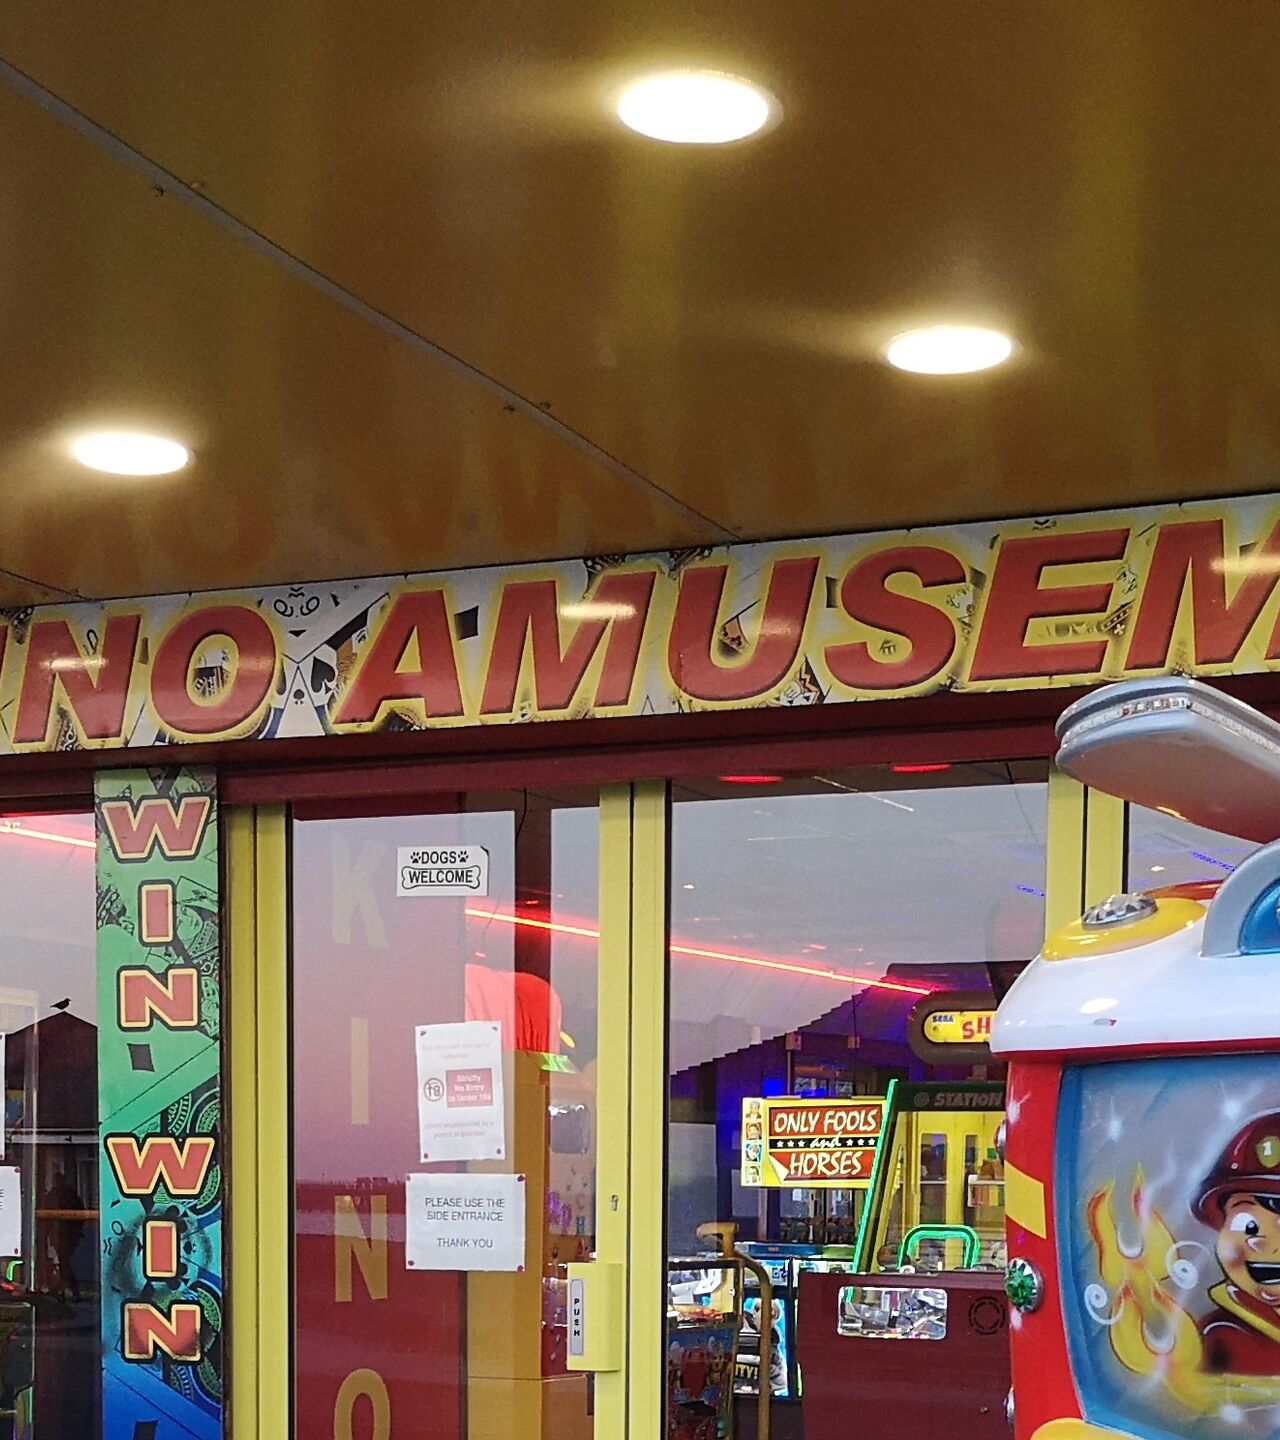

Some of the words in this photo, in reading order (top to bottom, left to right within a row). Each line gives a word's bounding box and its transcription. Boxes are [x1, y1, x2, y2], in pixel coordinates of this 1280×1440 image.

[421, 851, 457, 864] DOGS
[408, 870, 473, 883] WELCOME
[103, 796, 212, 1034] WIN
[774, 1111, 820, 1133] ONLY
[823, 1109, 878, 1133] FOOLS
[809, 1131, 842, 1148] and
[1263, 1141, 1272, 1156] 1
[789, 1151, 863, 1176] HORSES
[425, 1197, 461, 1208] PLEASE
[464, 1198, 485, 1208] USE
[487, 1198, 505, 1208] THE
[427, 1211, 449, 1221] SIDE
[451, 1211, 504, 1222] ENTRANCE
[106, 1134, 215, 1363] WIN
[437, 1237, 470, 1248] THANK
[472, 1238, 493, 1248] YOU
[573, 1298, 581, 1337] PUSH
